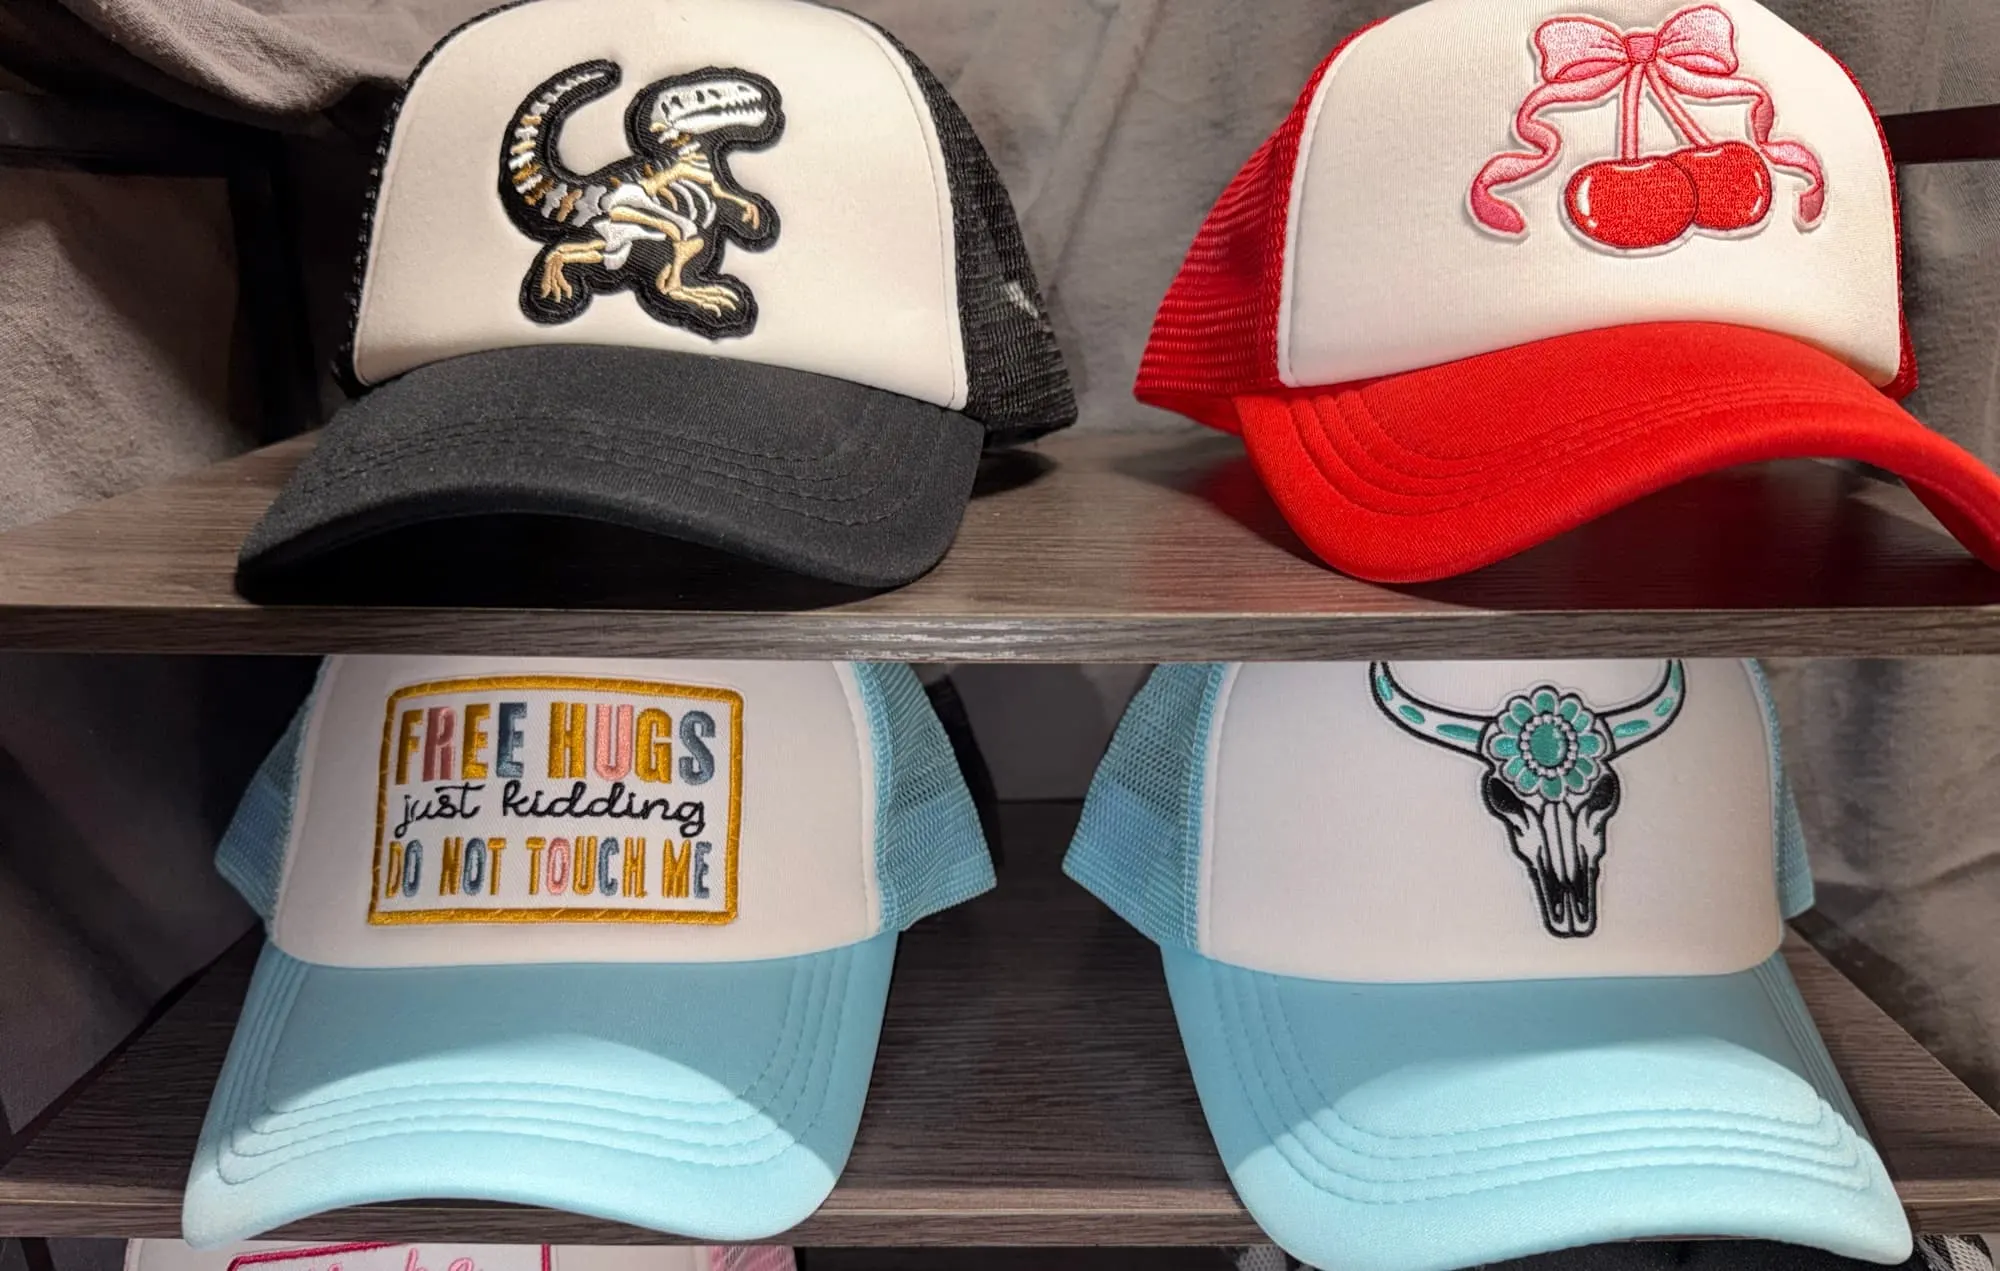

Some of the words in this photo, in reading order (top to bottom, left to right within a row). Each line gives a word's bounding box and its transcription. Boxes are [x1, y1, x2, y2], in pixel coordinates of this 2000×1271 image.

[395, 702, 527, 785] FREE
[548, 702, 716, 785] HUGS
[394, 782, 485, 838] just
[502, 779, 706, 838] kidding
[386, 839, 424, 897] DO
[439, 837, 506, 896] NOT
[526, 836, 647, 897] TOUCH
[662, 839, 713, 899] ME
